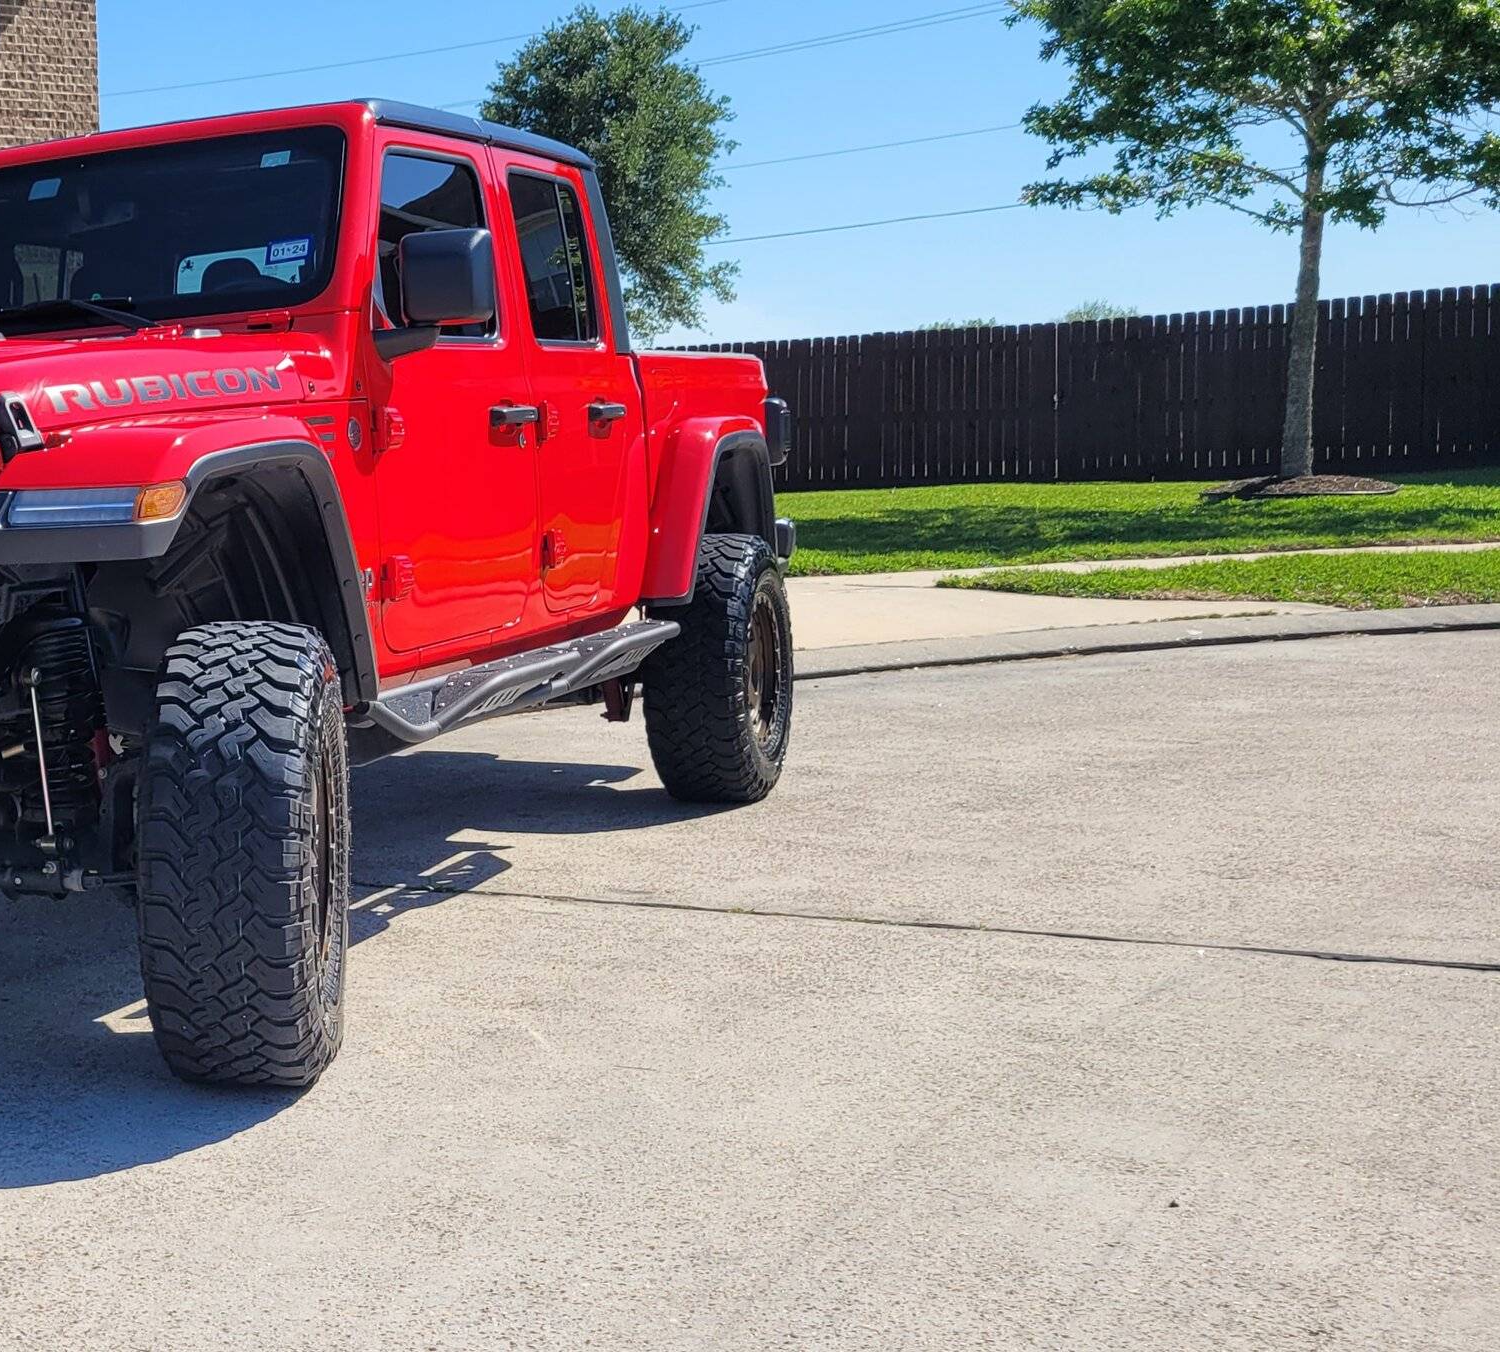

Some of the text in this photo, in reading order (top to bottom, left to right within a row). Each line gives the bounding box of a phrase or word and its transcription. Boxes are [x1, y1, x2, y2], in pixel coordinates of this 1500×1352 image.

[272, 244, 306, 258] 01 24
[43, 366, 281, 413] RUBICON
